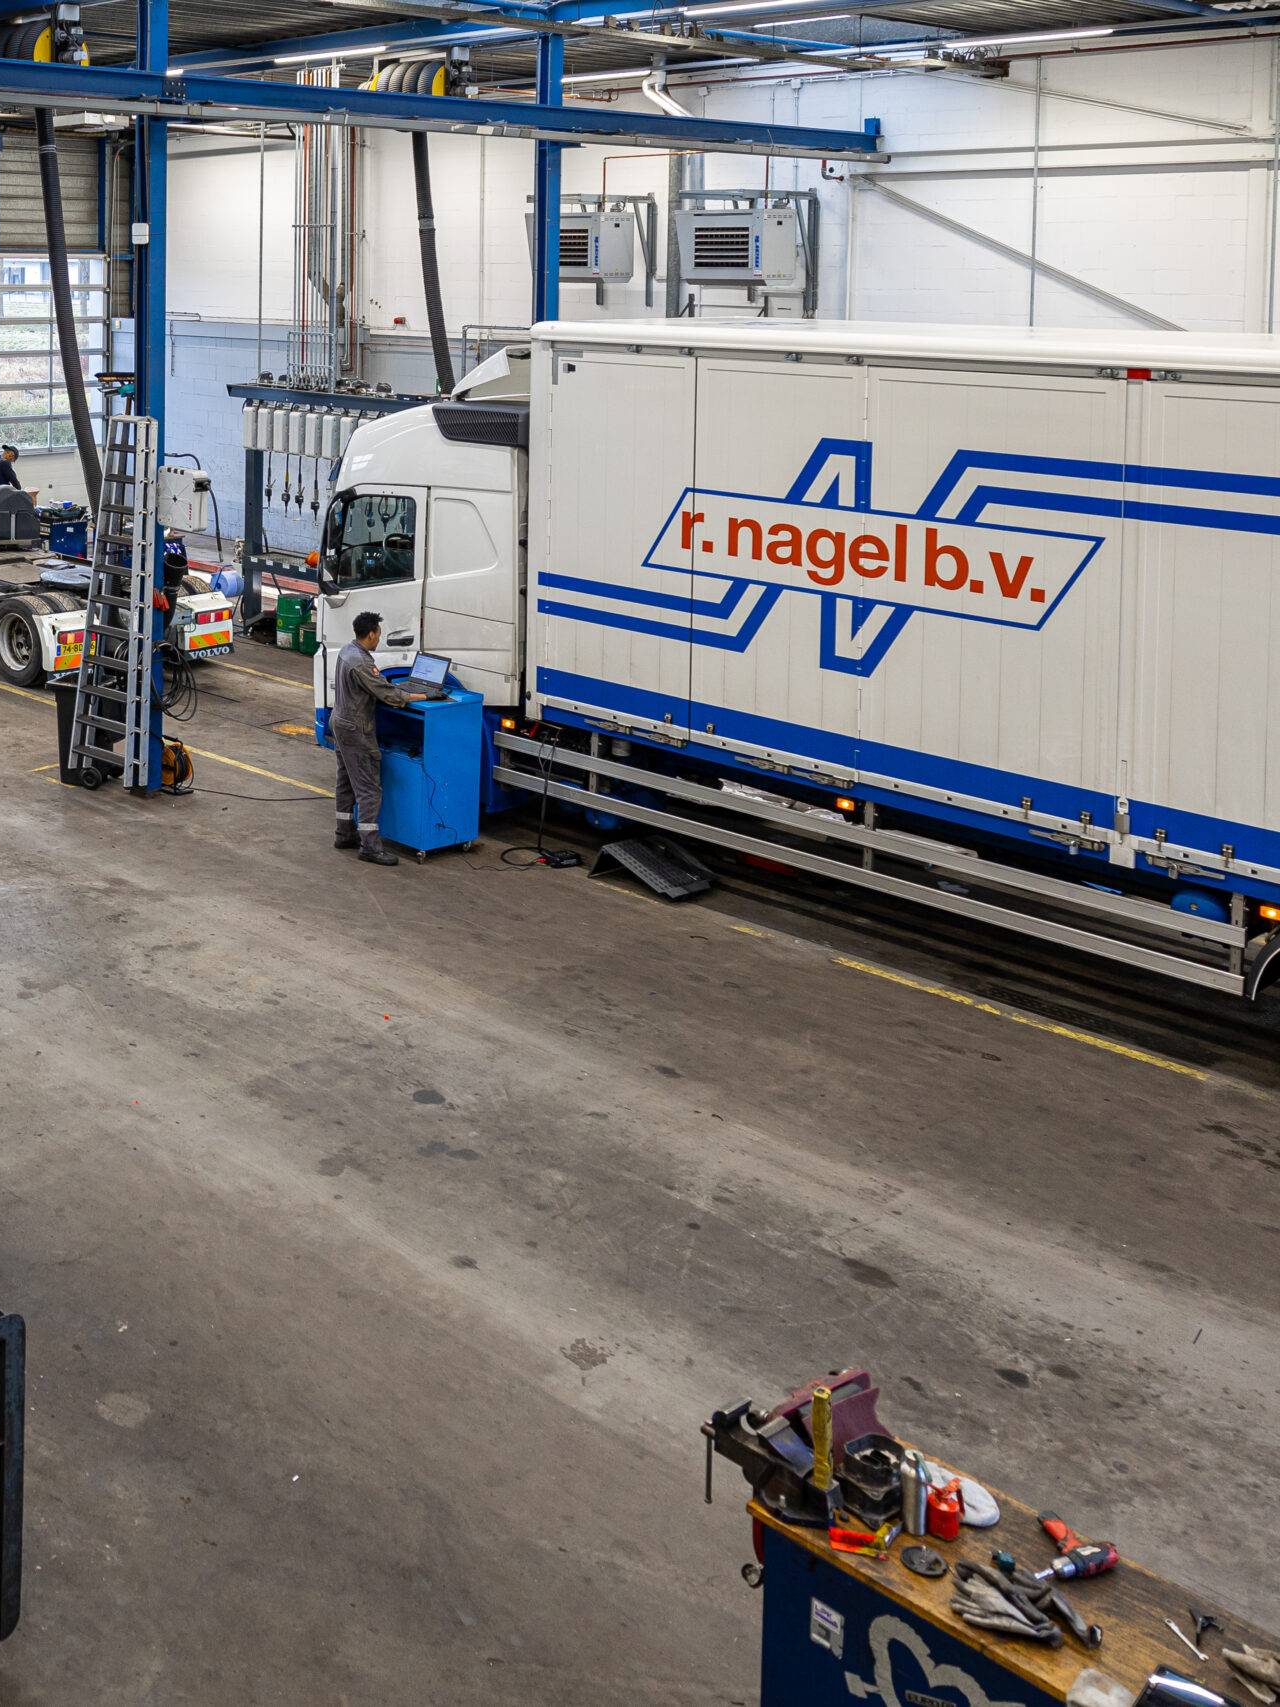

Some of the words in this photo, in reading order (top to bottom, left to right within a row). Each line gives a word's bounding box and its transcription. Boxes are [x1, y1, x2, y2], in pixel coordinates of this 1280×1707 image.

[681, 511, 714, 553] r.
[727, 517, 907, 586] nagel
[924, 528, 1046, 603] b.v.
[188, 646, 230, 660] VOLVO
